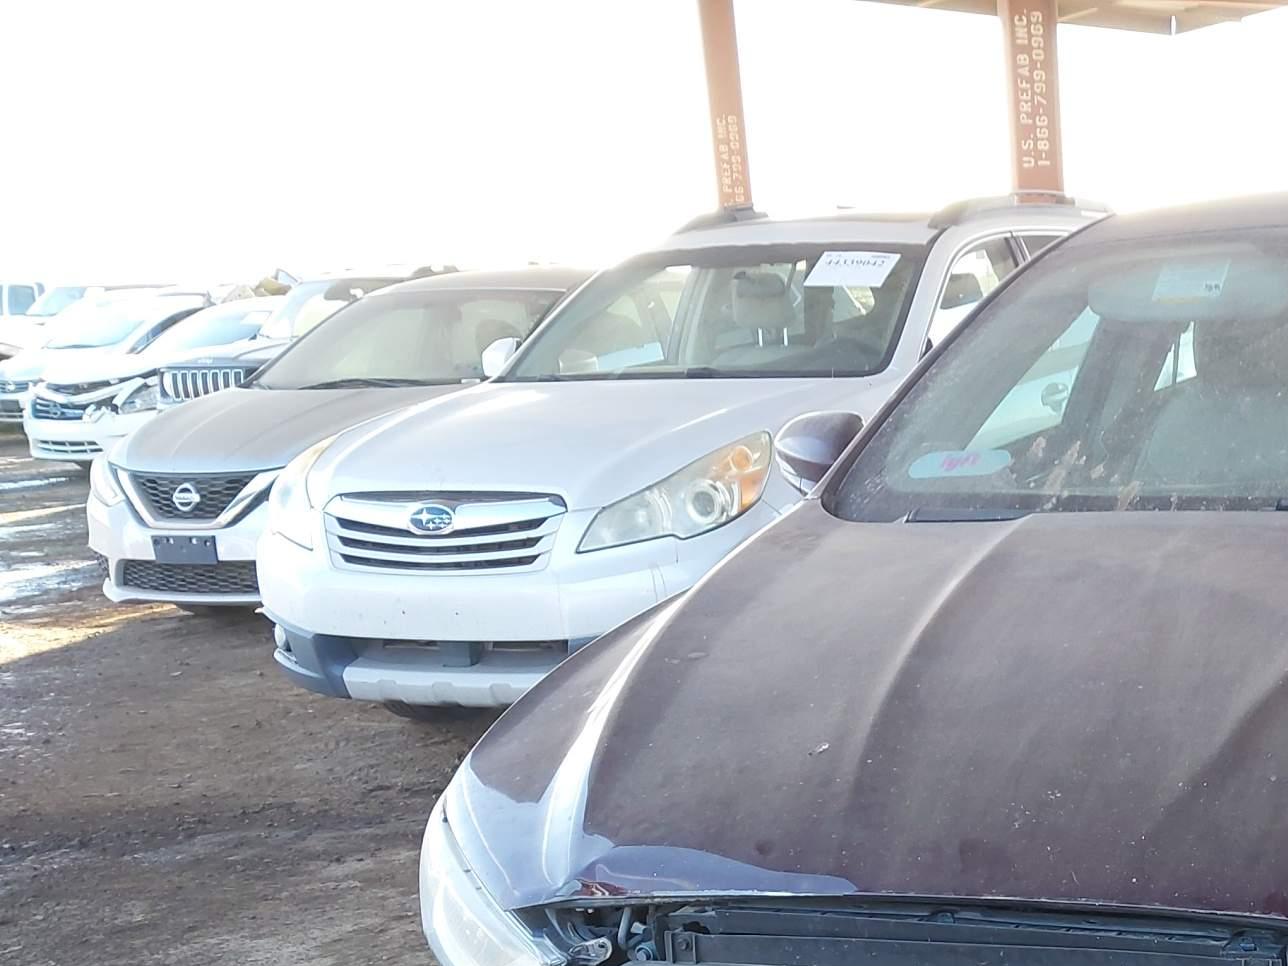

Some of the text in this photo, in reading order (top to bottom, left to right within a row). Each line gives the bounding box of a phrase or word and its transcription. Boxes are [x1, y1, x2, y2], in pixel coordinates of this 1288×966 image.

[1014, 9, 1035, 168] U.S. PREFAB INC.
[1030, 11, 1051, 167] 1-866-799-0969
